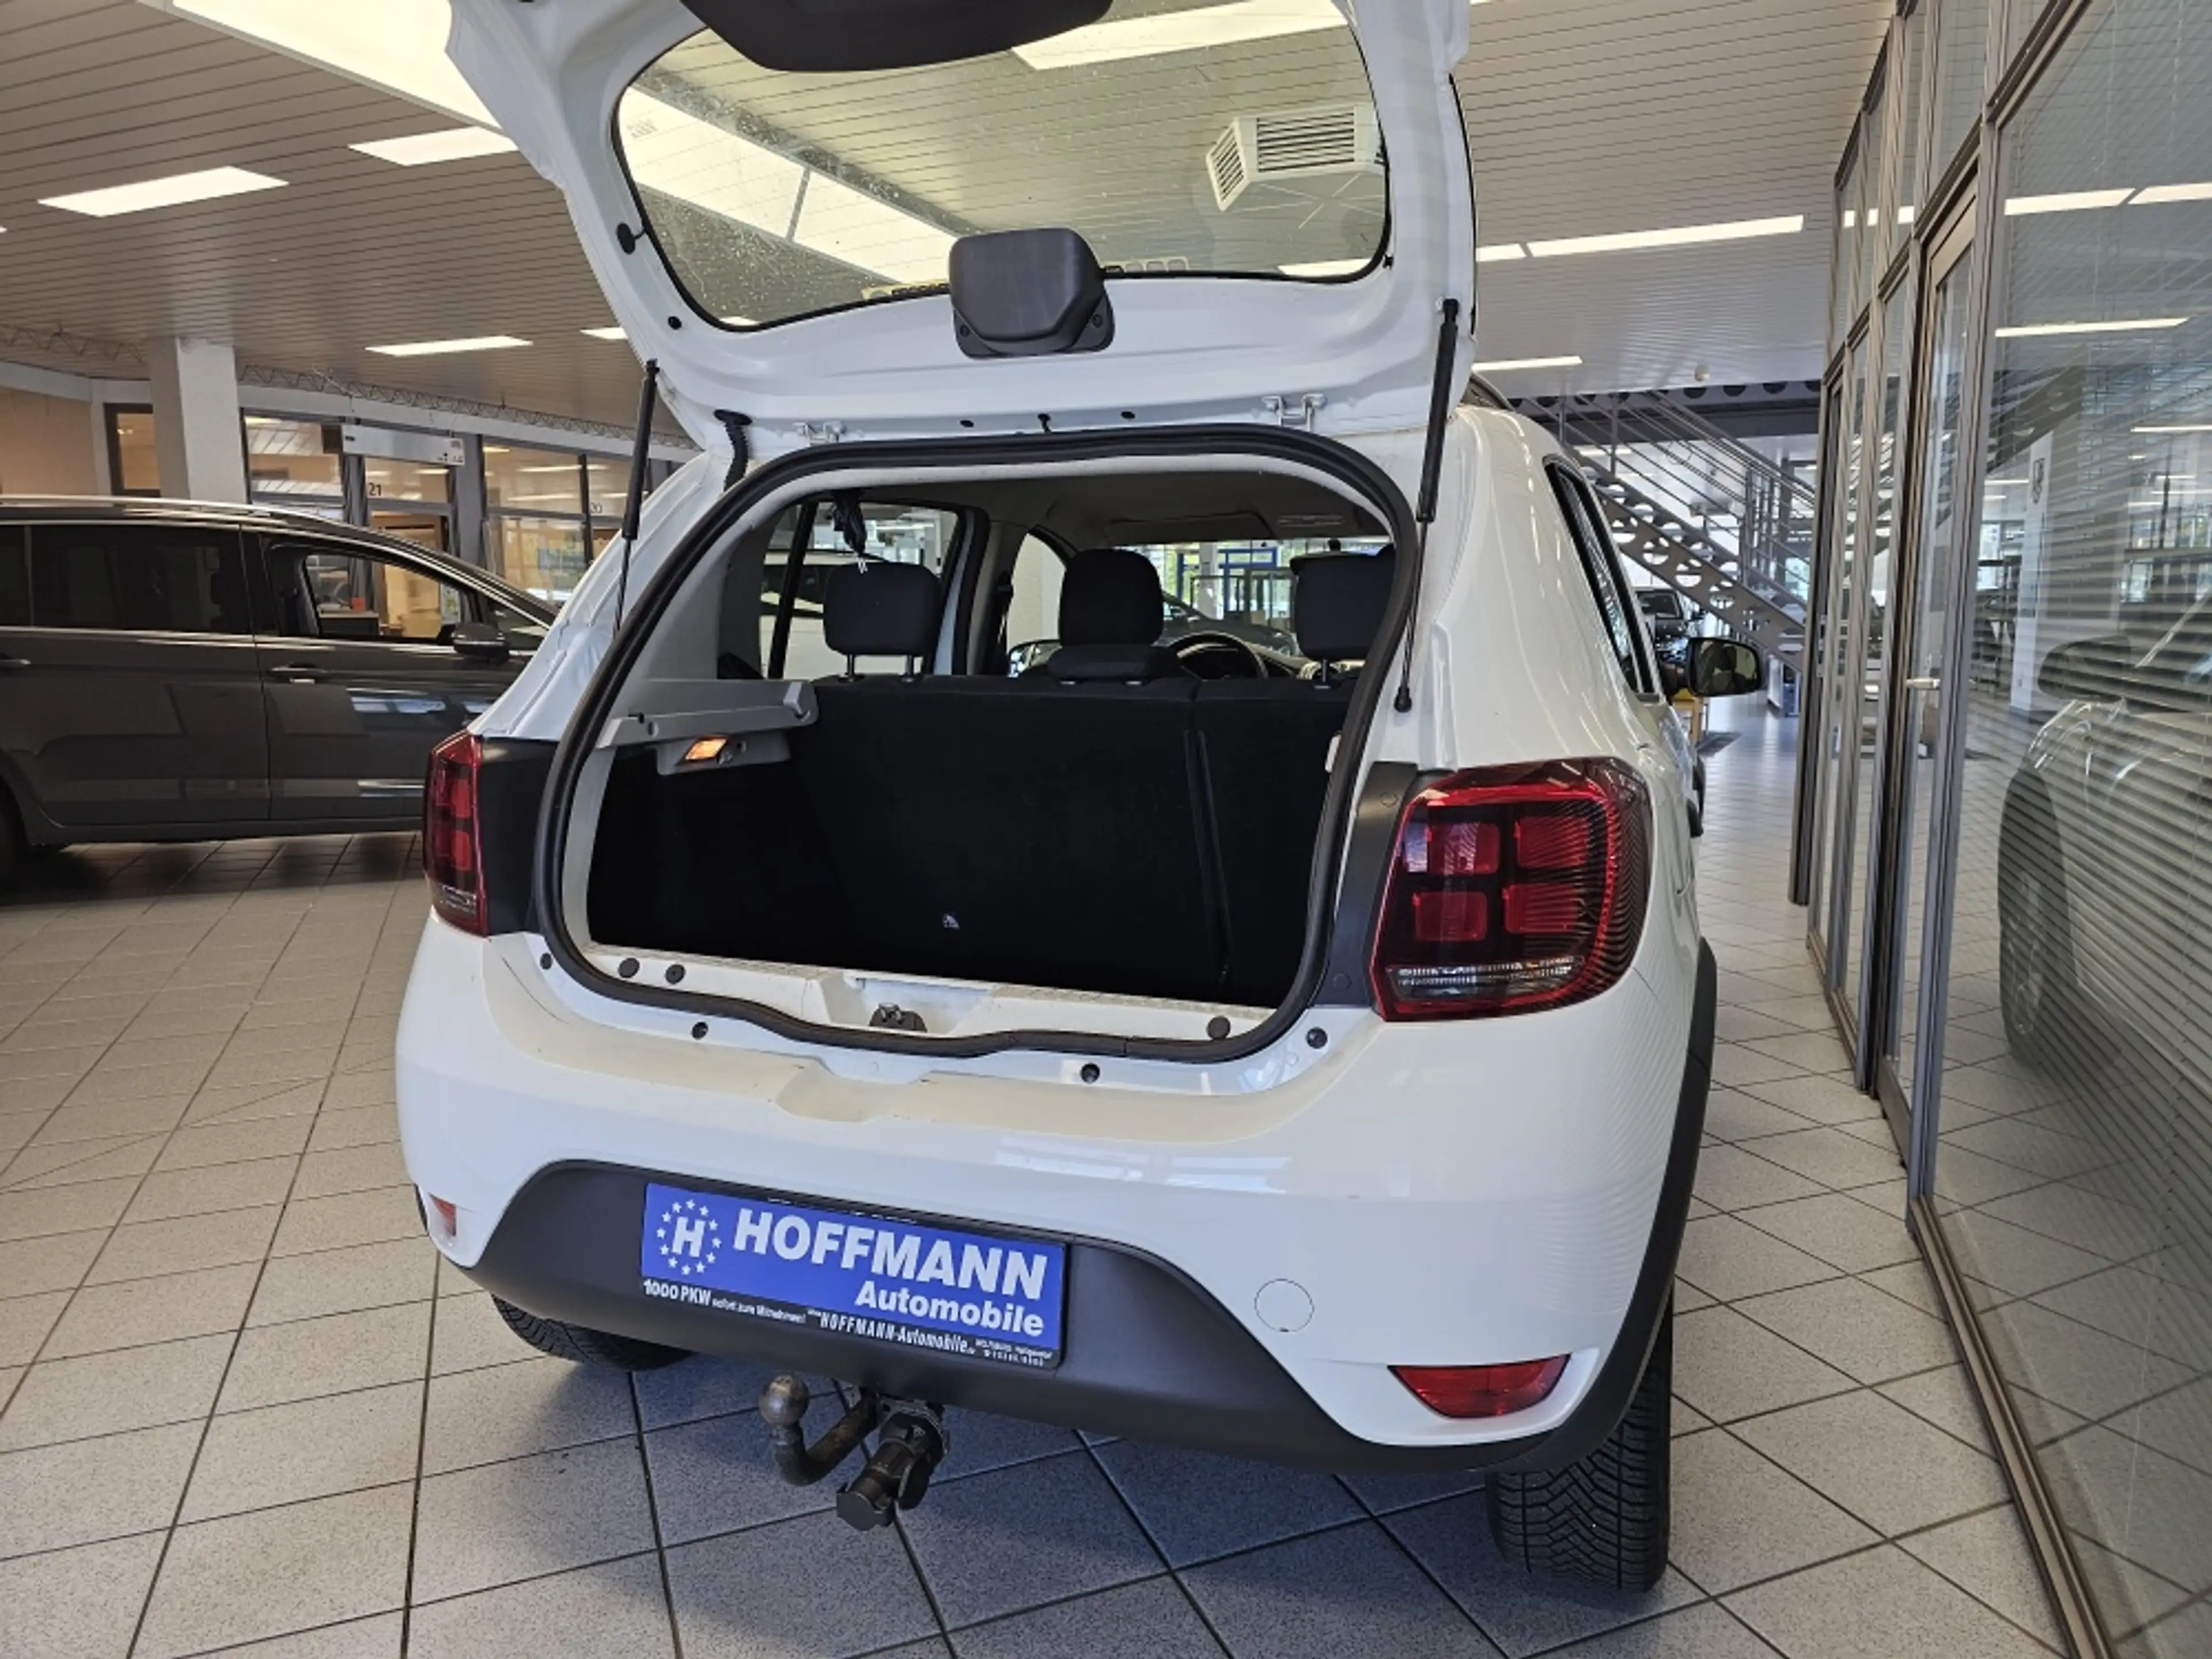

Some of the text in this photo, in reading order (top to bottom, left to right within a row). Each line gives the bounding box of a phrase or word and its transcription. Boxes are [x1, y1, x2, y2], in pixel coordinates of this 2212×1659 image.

[368, 482, 382, 497] 21
[672, 1207, 1047, 1301] H HOFFMANN
[643, 1278, 678, 1300] 1000
[680, 1285, 712, 1306] PKW
[854, 1279, 1045, 1337] Automobile
